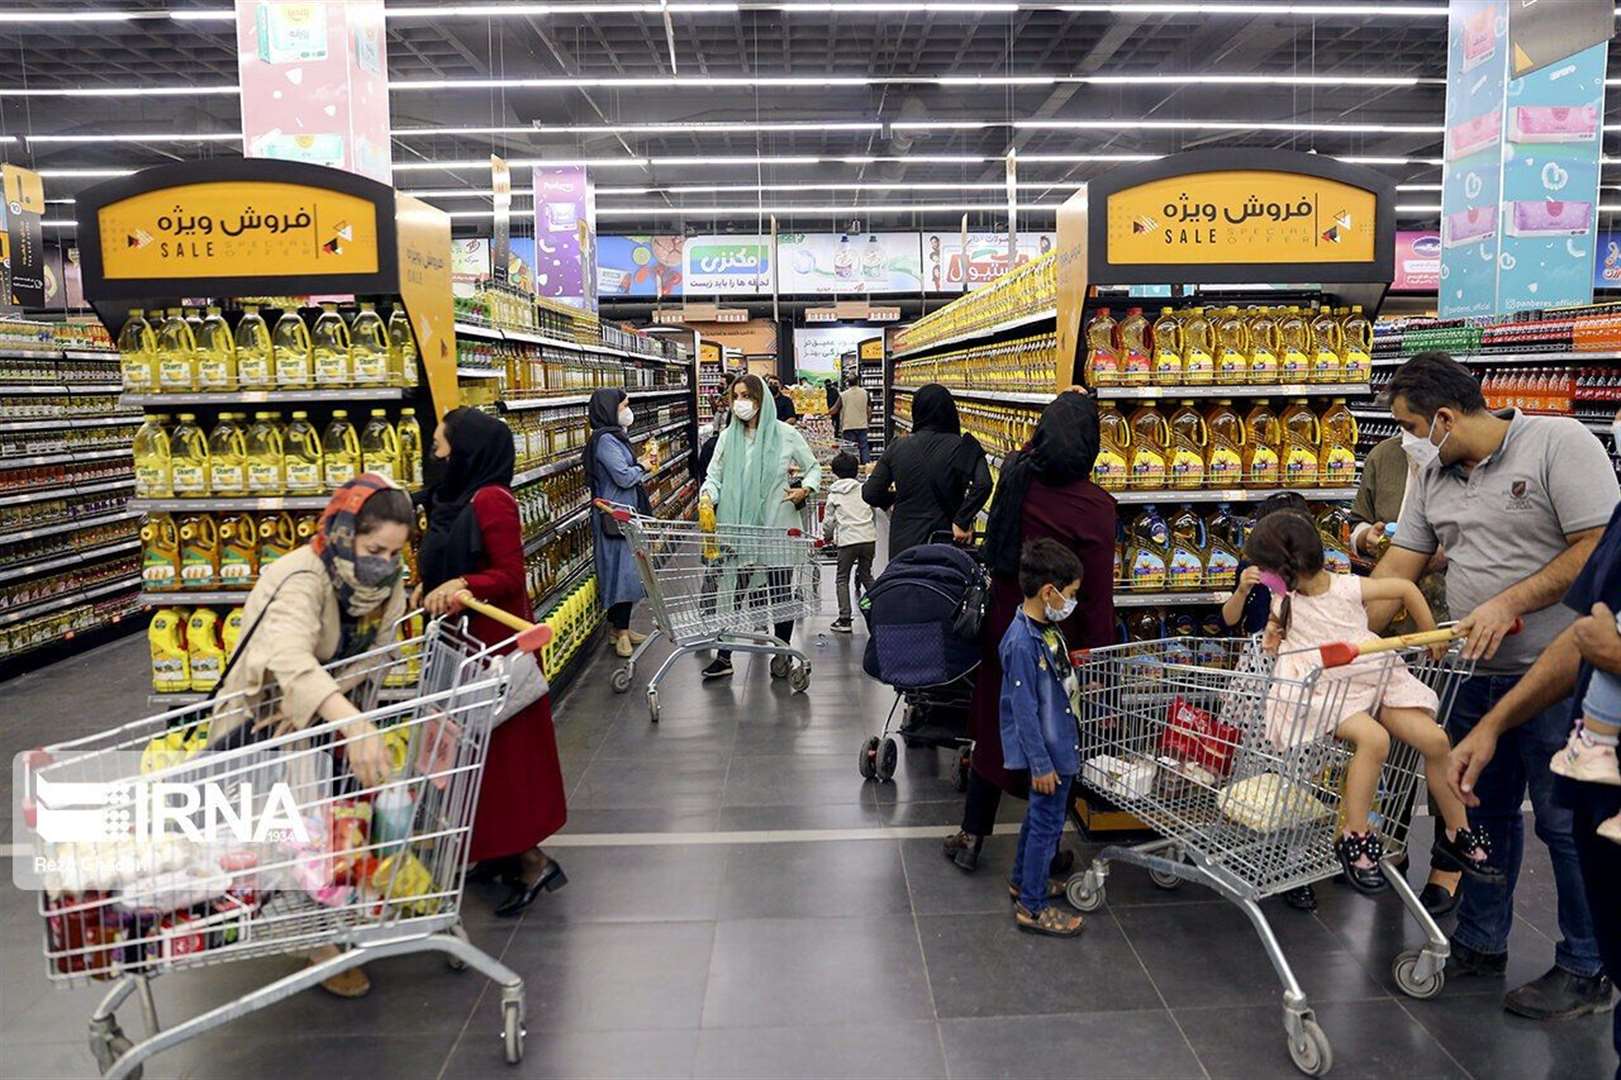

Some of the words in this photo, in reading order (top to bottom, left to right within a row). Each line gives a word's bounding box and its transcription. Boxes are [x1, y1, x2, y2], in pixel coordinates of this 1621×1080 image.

[157, 205, 214, 236] ویژه
[220, 206, 312, 237] فروش
[1163, 193, 1217, 223] ویژه
[1223, 195, 1313, 225] فروش
[160, 241, 214, 258] SALE
[1165, 228, 1217, 245] SALE
